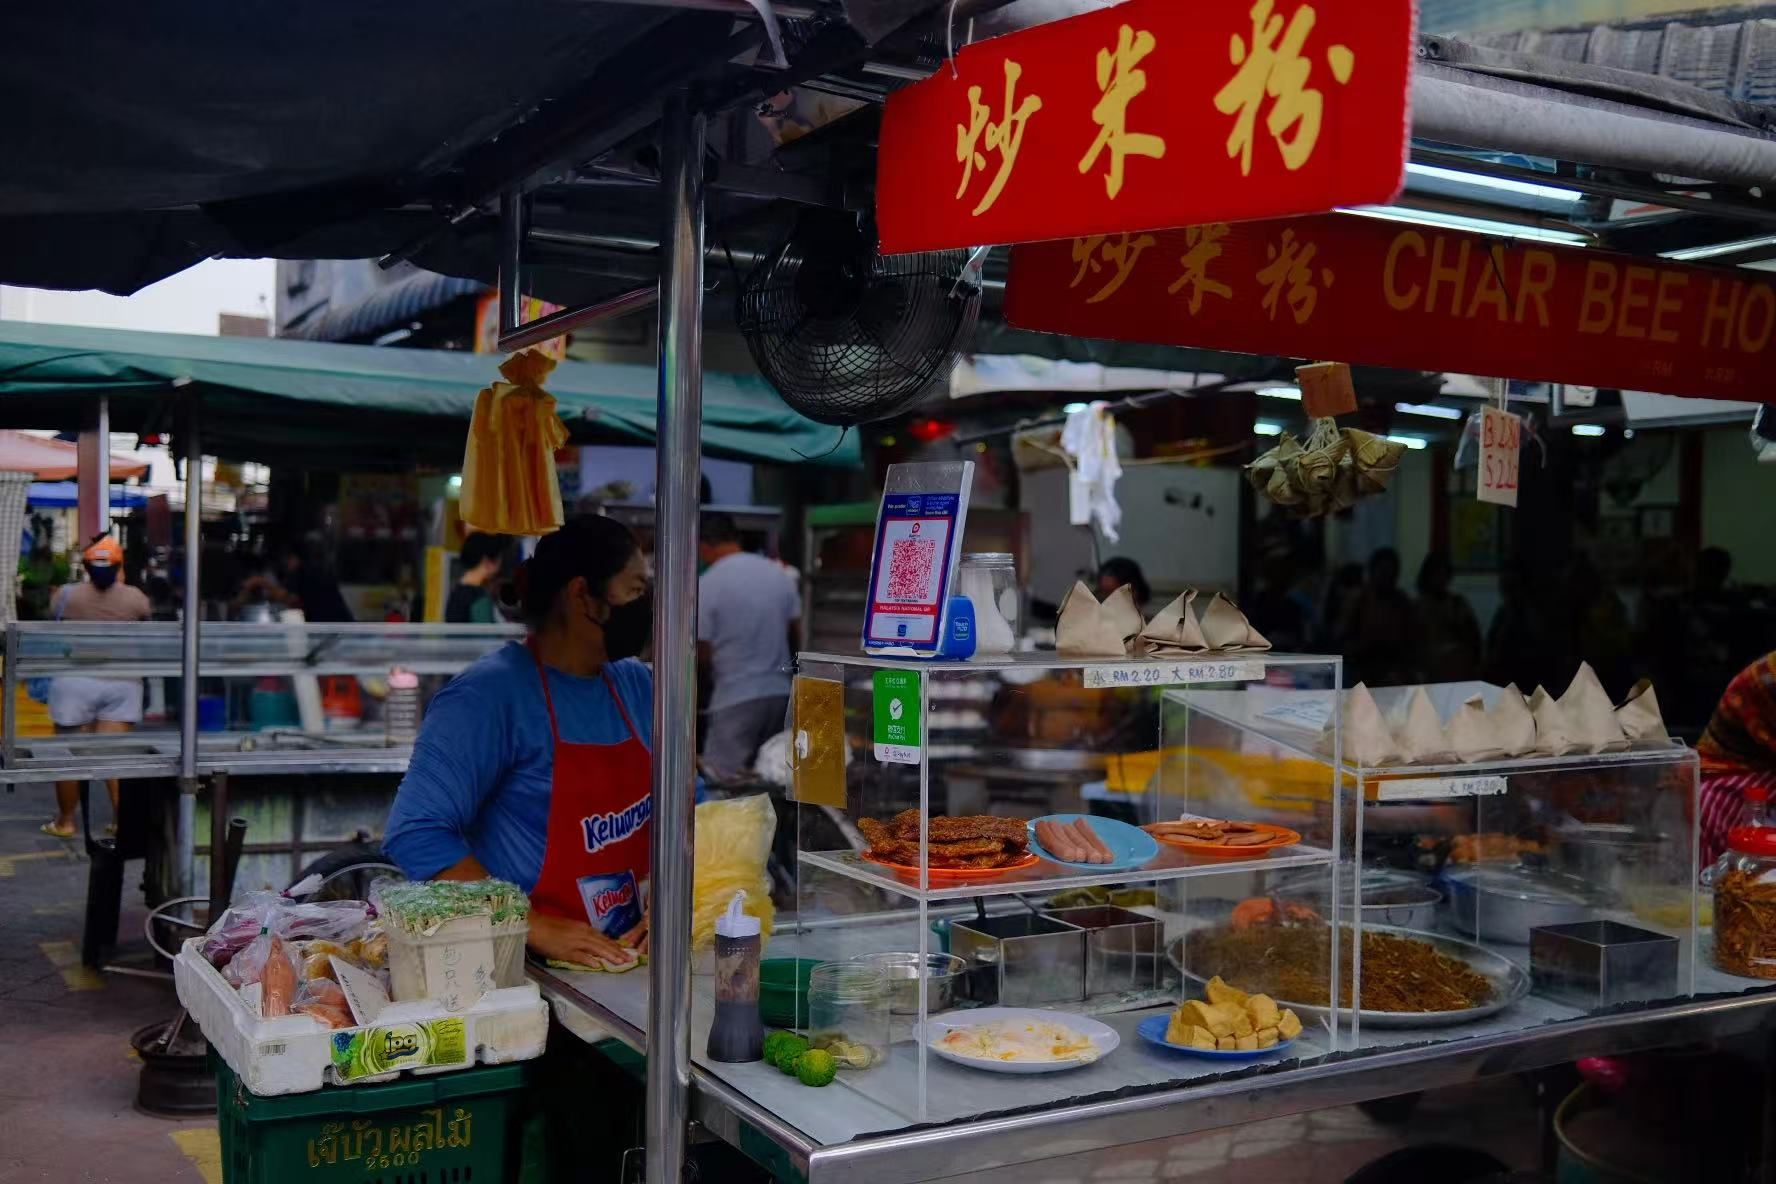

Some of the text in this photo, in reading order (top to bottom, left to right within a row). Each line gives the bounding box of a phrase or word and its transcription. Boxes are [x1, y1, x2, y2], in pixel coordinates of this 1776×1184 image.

[956, 0, 1354, 216] 炒米粉
[1070, 223, 1335, 324] 炒米粉
[1383, 231, 1775, 353] CHAR BEE HO
[1484, 414, 1494, 448] B
